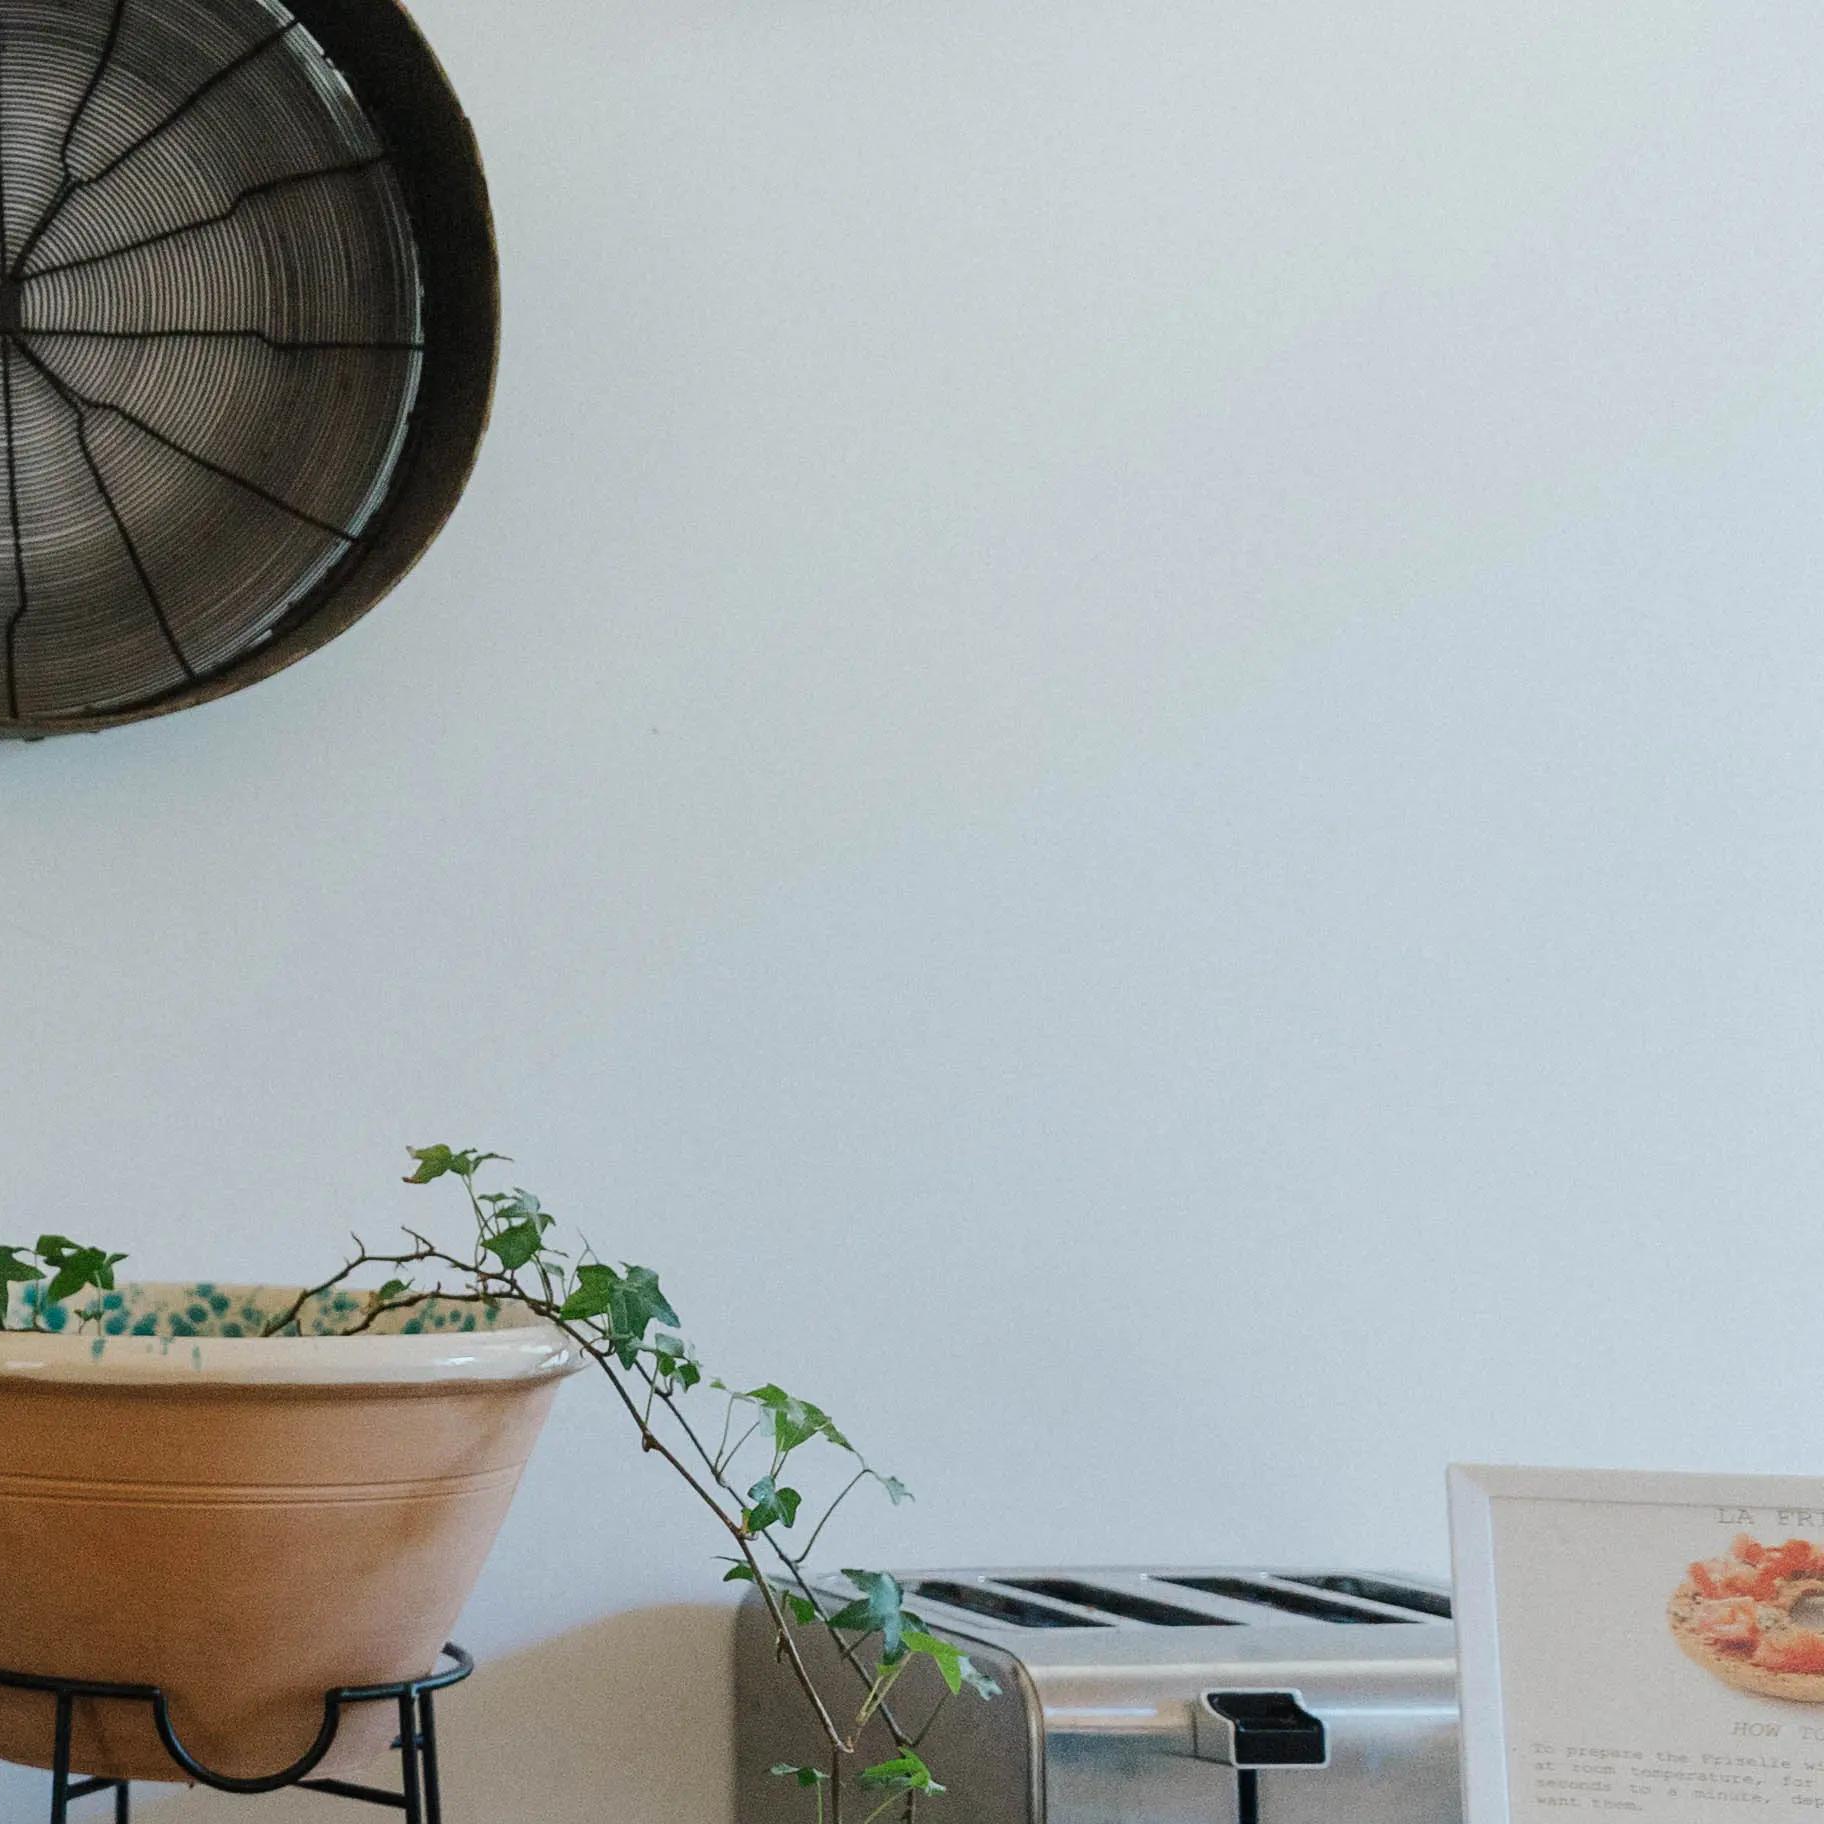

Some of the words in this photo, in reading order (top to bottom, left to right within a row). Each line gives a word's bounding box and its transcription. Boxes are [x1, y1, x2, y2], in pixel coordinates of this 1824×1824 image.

[1716, 1507, 1755, 1525] LA
[1732, 1721, 1780, 1737] HOW
[1531, 1743, 1554, 1754] To
[1565, 1746, 1643, 1760] prepare
[1656, 1751, 1689, 1763] the
[1535, 1761, 1554, 1771] at
[1572, 1763, 1616, 1776] room
[1630, 1766, 1765, 1786] temperature,
[1783, 1775, 1815, 1788] for
[1535, 1778, 1612, 1793] seconds
[1629, 1783, 1651, 1795] to
[1693, 1789, 1770, 1804] minute,
[1536, 1797, 1582, 1808] want
[1591, 1798, 1643, 1812] them.
